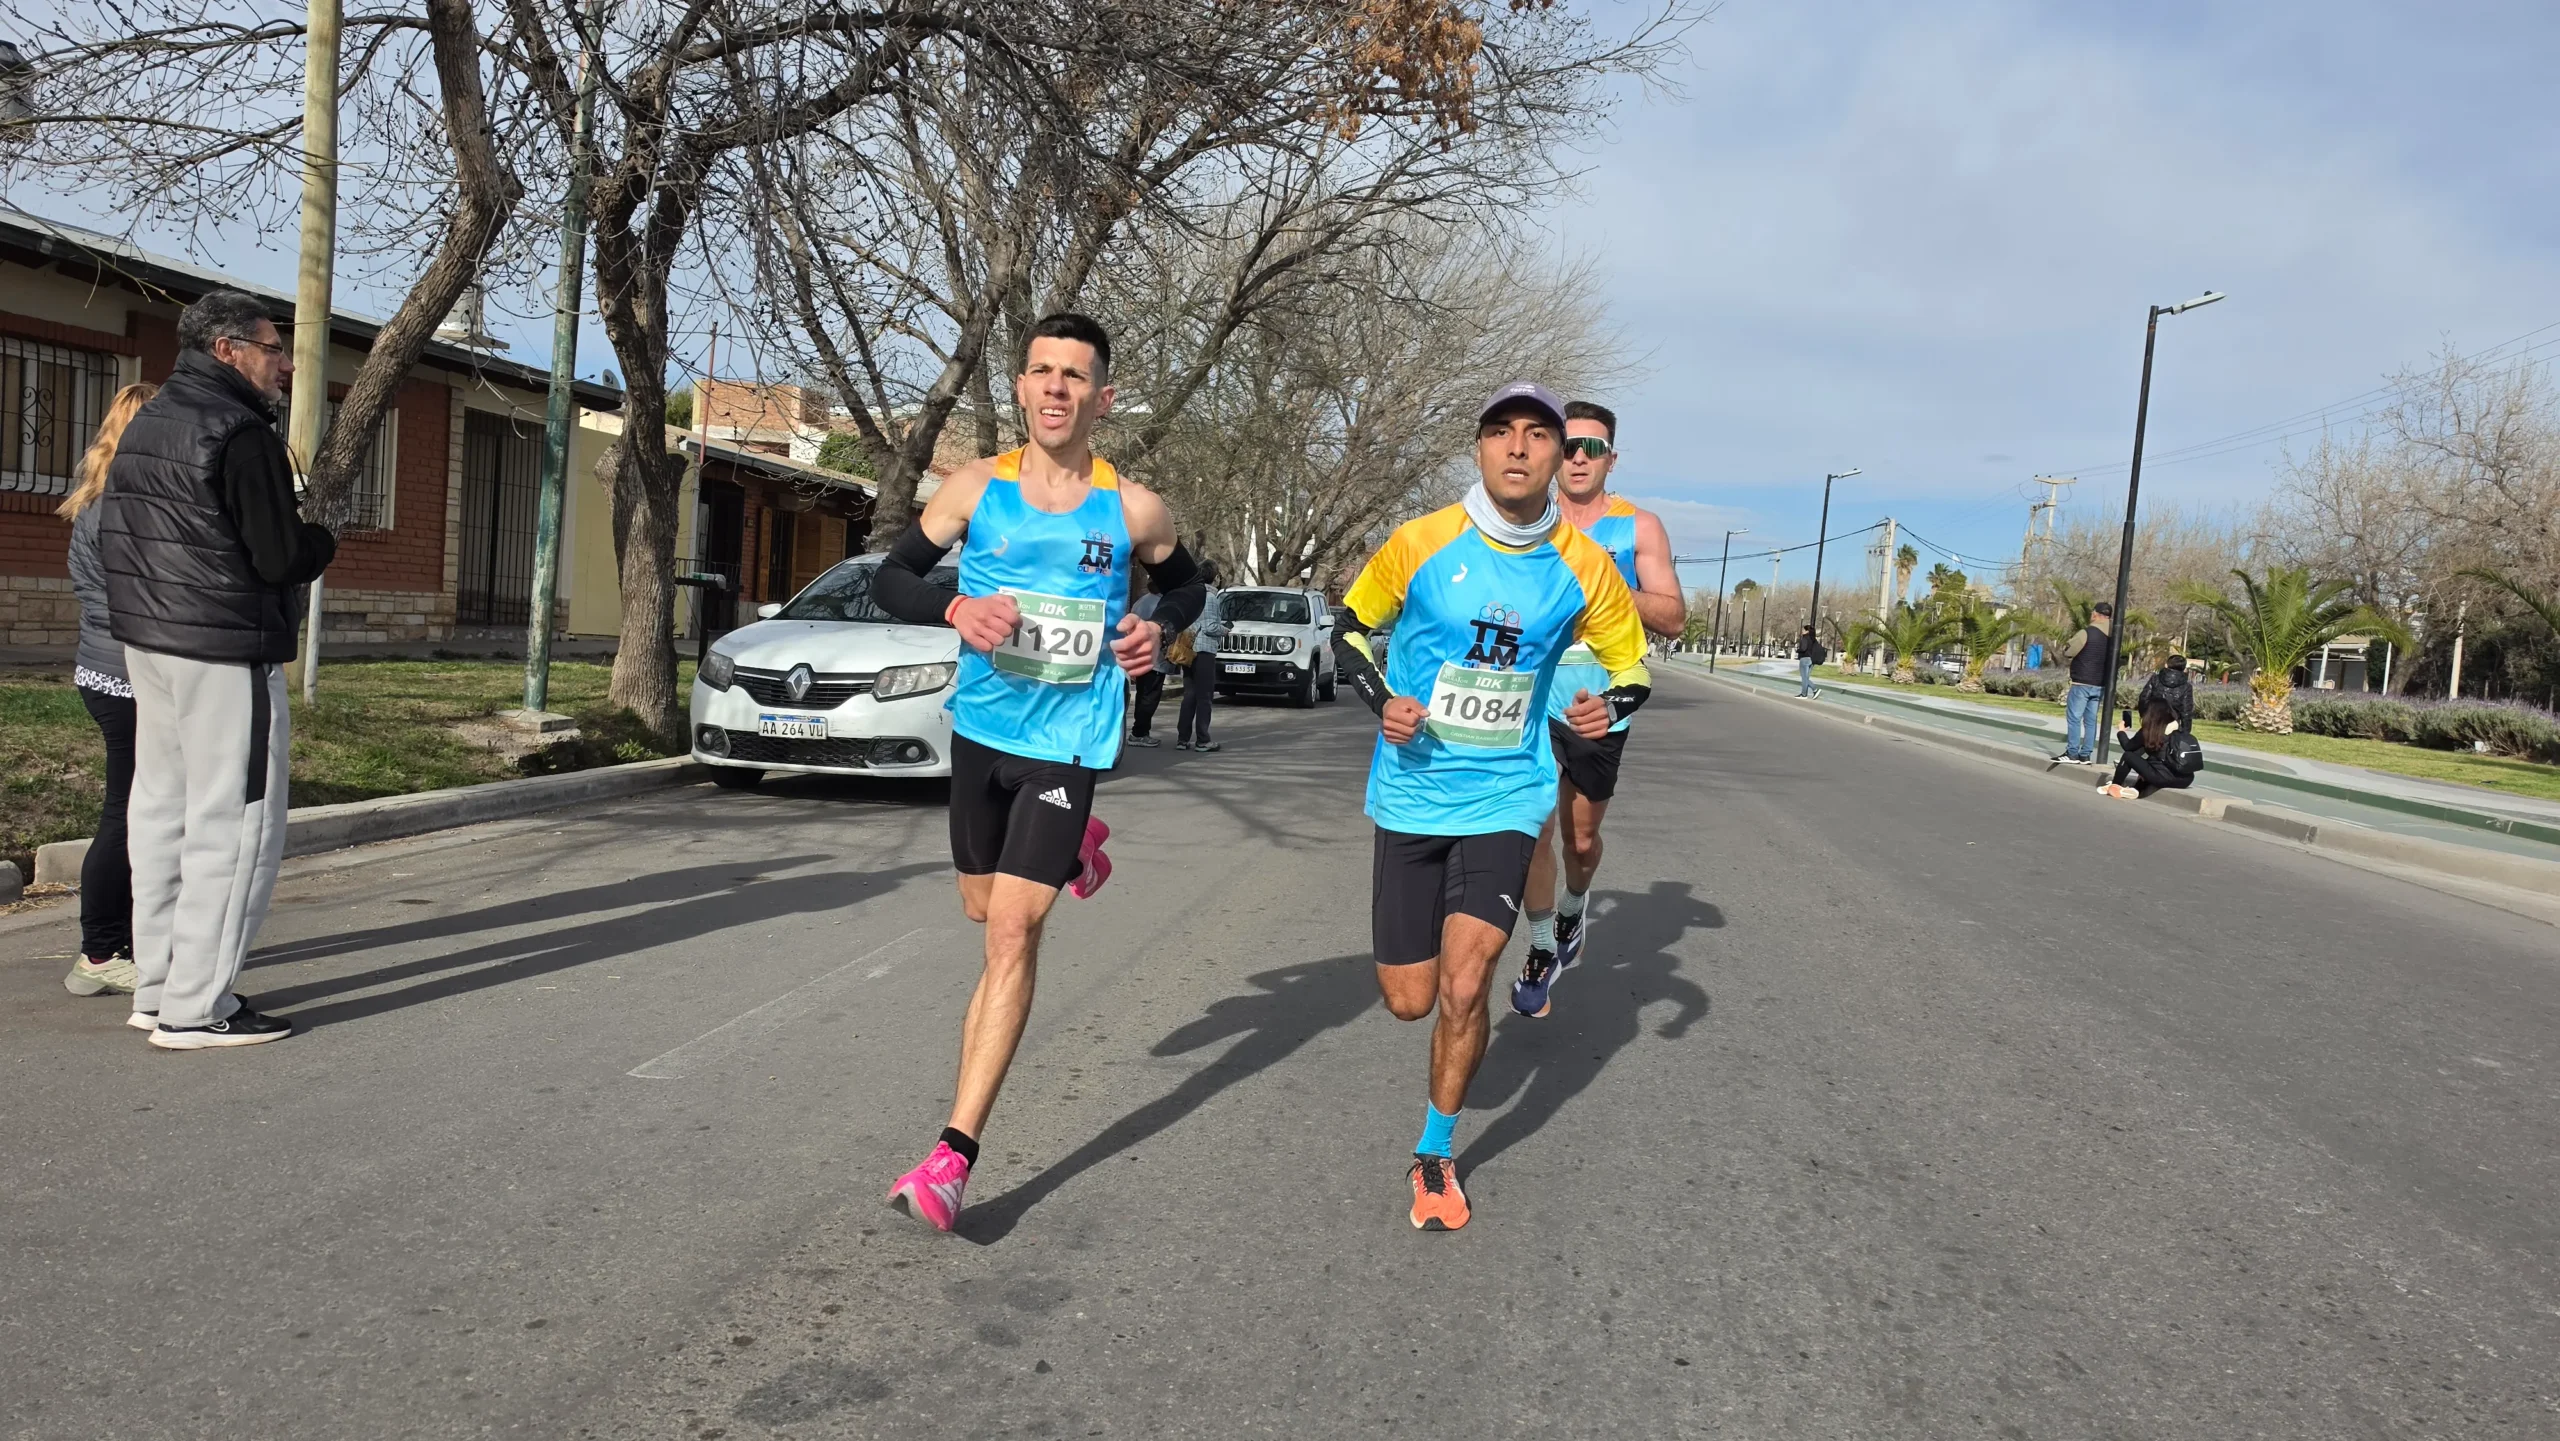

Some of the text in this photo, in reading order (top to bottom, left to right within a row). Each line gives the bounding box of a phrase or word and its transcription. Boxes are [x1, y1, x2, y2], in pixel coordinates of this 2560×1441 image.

[1038, 602, 1070, 617] 10K
[1012, 624, 1093, 657] 1120
[1475, 676, 1504, 689] 10K
[1440, 692, 1523, 723] 1084
[762, 721, 823, 737] AA 264 VU
[1450, 731, 1475, 740] CRISTIAN
[1038, 793, 1072, 810] adidas
